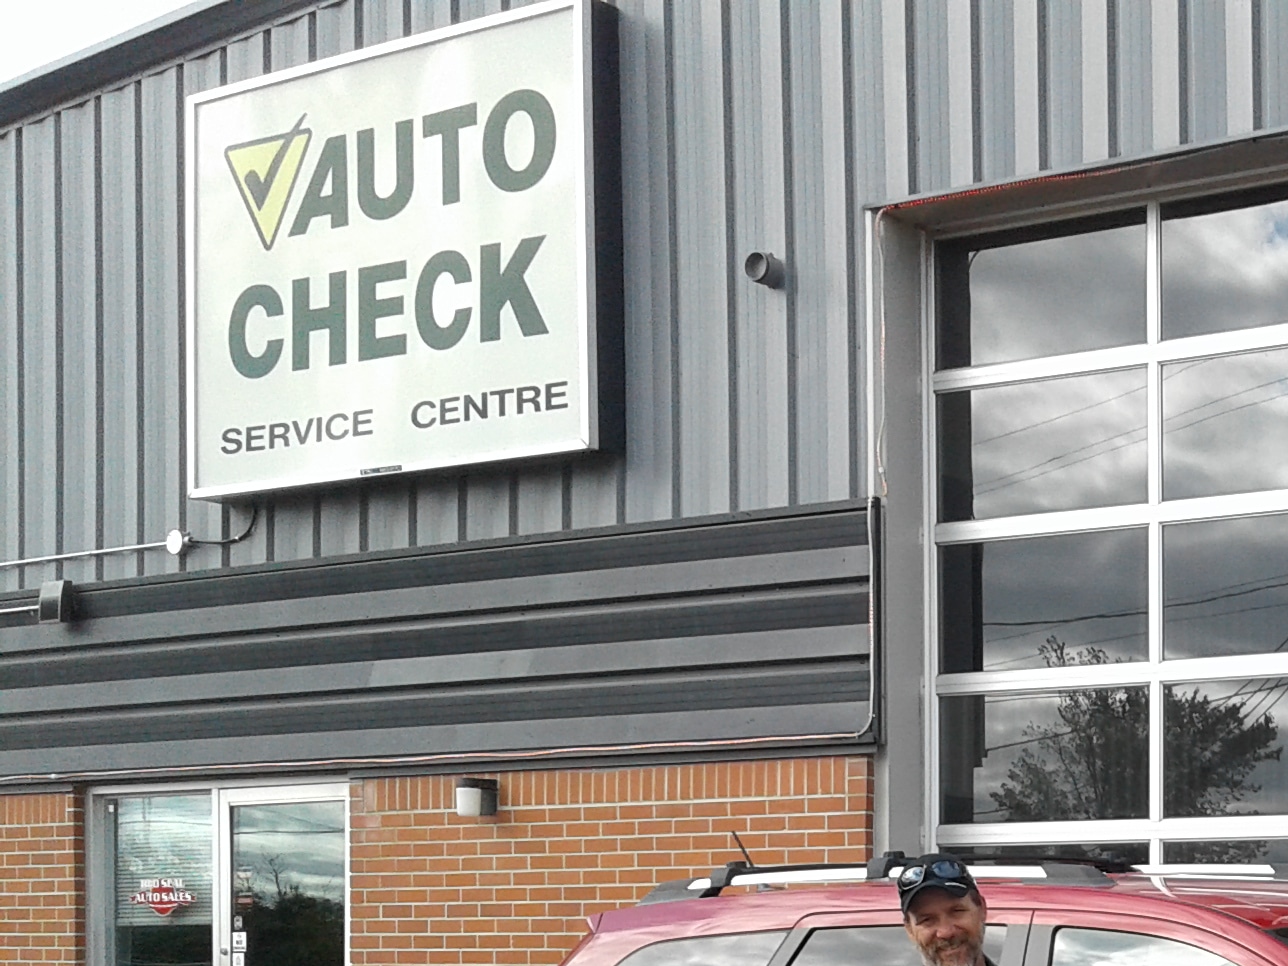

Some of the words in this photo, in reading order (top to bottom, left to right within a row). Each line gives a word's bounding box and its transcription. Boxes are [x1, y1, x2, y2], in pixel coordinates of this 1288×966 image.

[288, 88, 557, 237] AUTO
[228, 234, 549, 379] CHECK
[220, 408, 374, 455] SERVICE
[410, 381, 569, 430] CENTRE
[136, 892, 160, 902] AUTO
[161, 891, 192, 902] SALES
